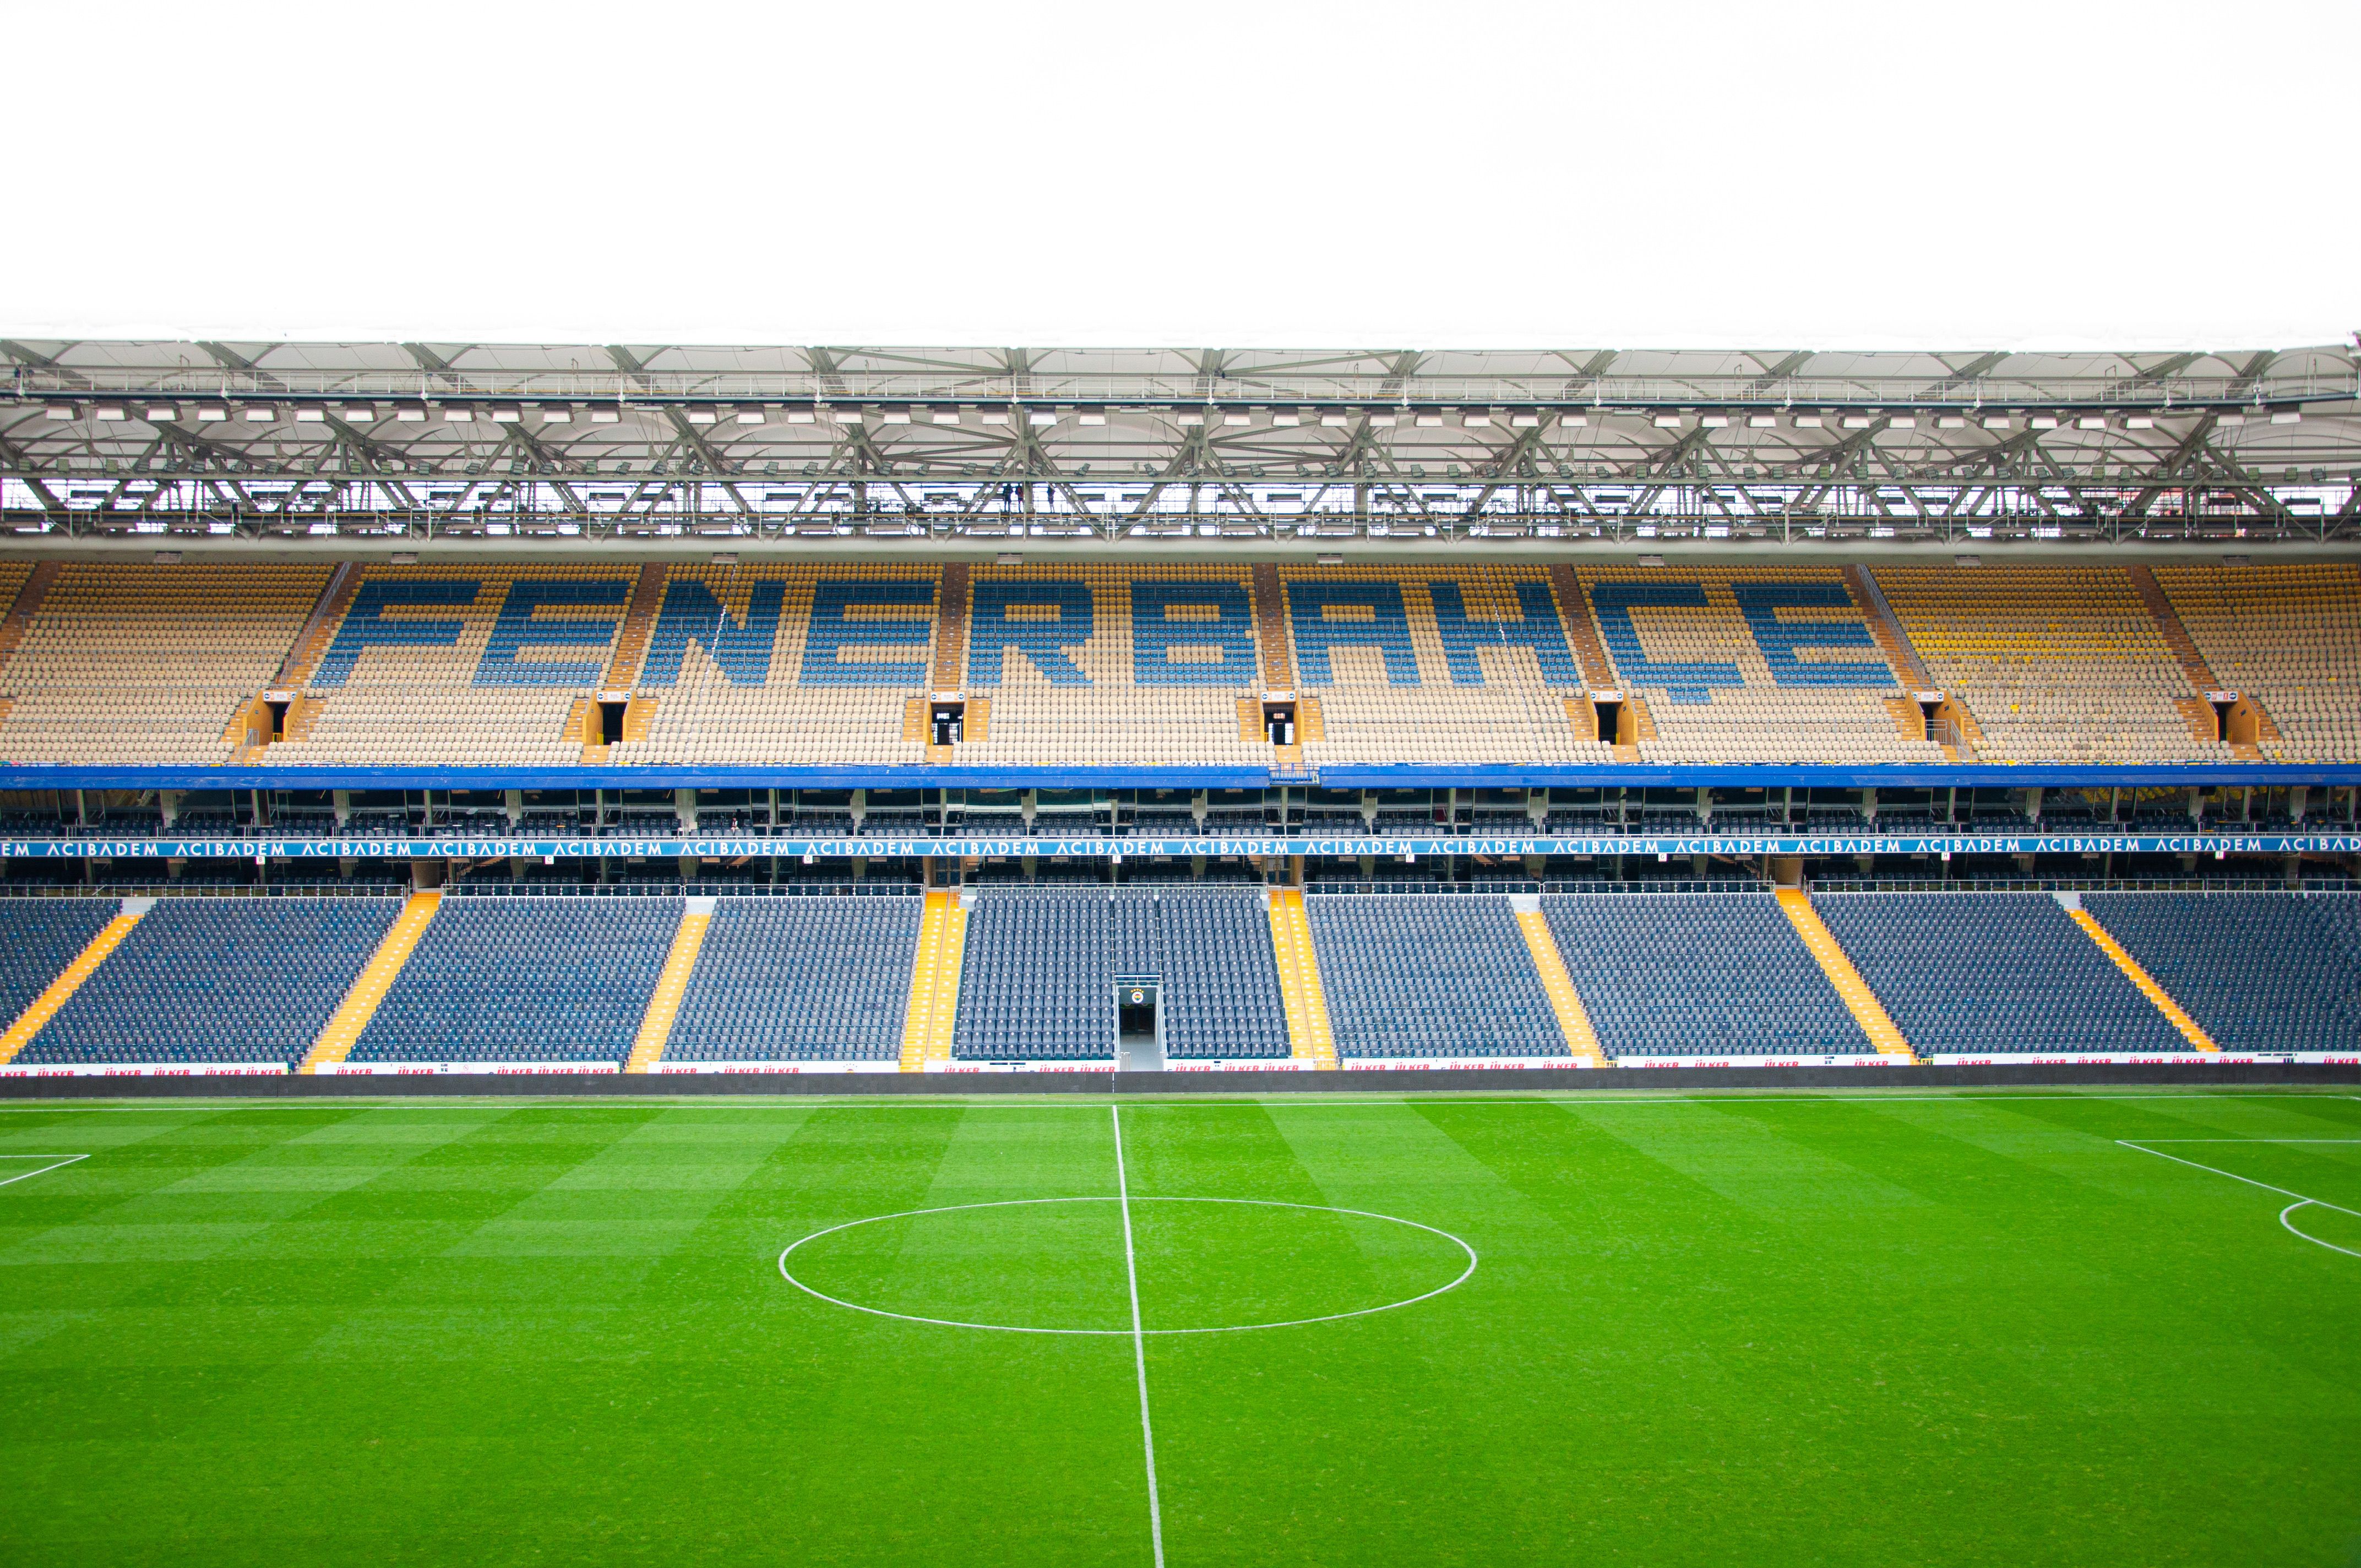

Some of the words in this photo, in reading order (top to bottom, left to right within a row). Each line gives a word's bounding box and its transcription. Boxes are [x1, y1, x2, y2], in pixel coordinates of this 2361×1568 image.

[312, 581, 1897, 705] FENERBAHÇE
[47, 843, 157, 856] ACIBADEM
[176, 843, 285, 855] ACIBADEM
[302, 843, 410, 855] ACIBADEM
[428, 843, 536, 854] ACIBADEM
[554, 843, 661, 854] ACIBADEM
[681, 843, 788, 854] ACIBADEM
[806, 843, 913, 854] ACIBADEM
[932, 843, 1039, 853] ACIBADEM
[1057, 842, 1163, 853] ACIBADEM
[1182, 842, 1288, 853] ACIBADEM
[1305, 842, 1412, 853] ACIBADEM
[1429, 841, 1535, 852] ACIBADEM
[1554, 841, 1658, 852] ACIBADEM
[1675, 841, 1779, 852] ACIBADEM
[1797, 840, 1900, 851] ACIBADEM
[1917, 840, 2019, 851] ACIBADEM
[2036, 839, 2139, 851] ACIBADEM
[2156, 839, 2260, 850] ACIBADEM
[2278, 838, 2361, 850] ACIBAD
